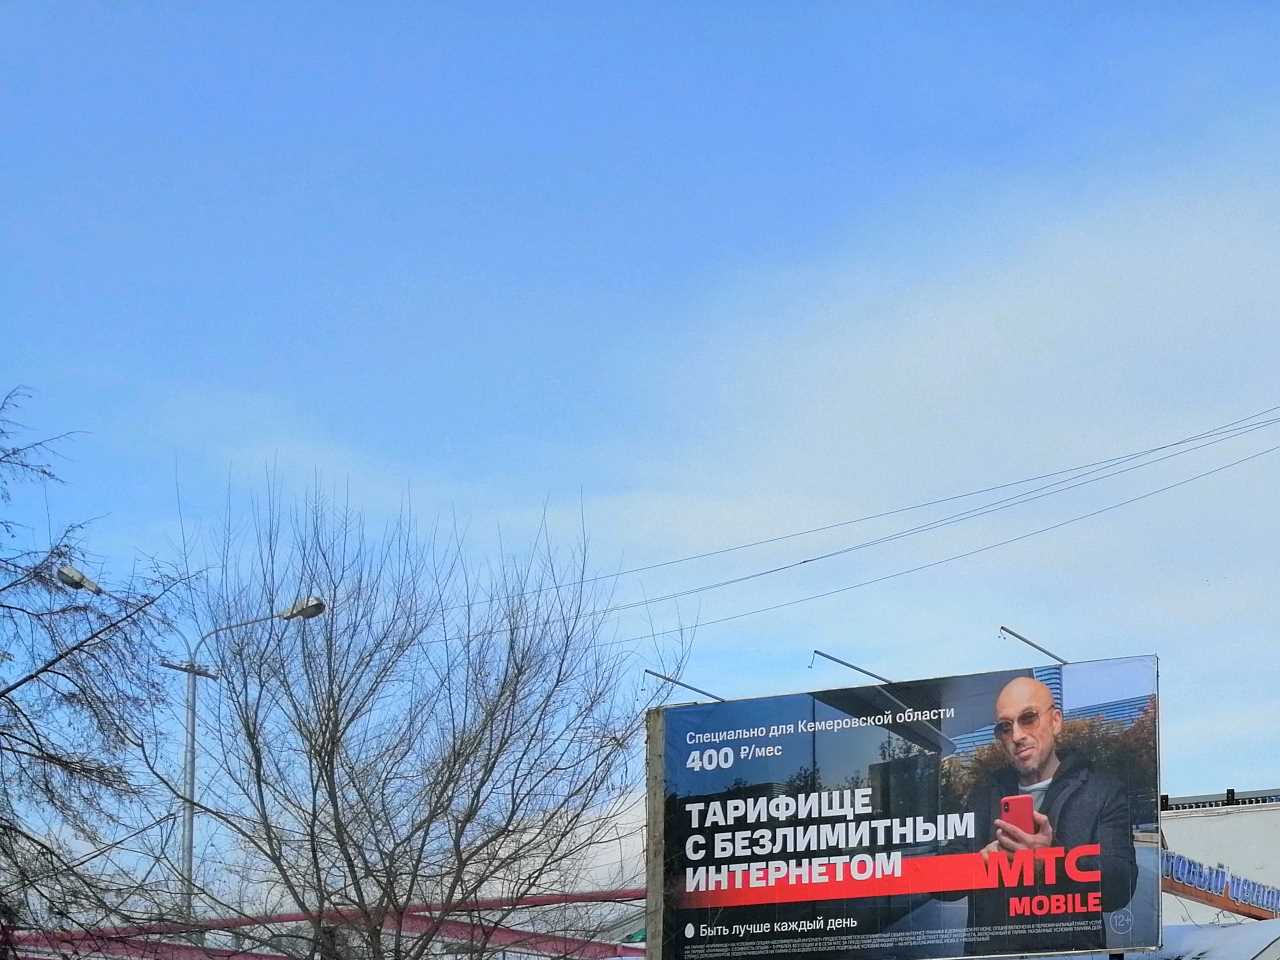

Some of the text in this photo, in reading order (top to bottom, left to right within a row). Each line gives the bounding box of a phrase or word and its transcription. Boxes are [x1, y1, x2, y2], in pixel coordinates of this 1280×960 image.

[686, 708, 955, 745] Специально для Кемеровской области
[686, 745, 782, 771] 400 ₽/мес
[685, 788, 872, 828] ТАРИФИЩЕ
[685, 812, 975, 860] С БЕЗЛИМИТНЫМ
[685, 852, 902, 892] ИНТЕРНЕТОМ
[986, 844, 1102, 888] МТС
[1009, 892, 1102, 917] MOBILE
[1113, 914, 1131, 928] 12+
[700, 916, 857, 937] Быть лучше каждый день
